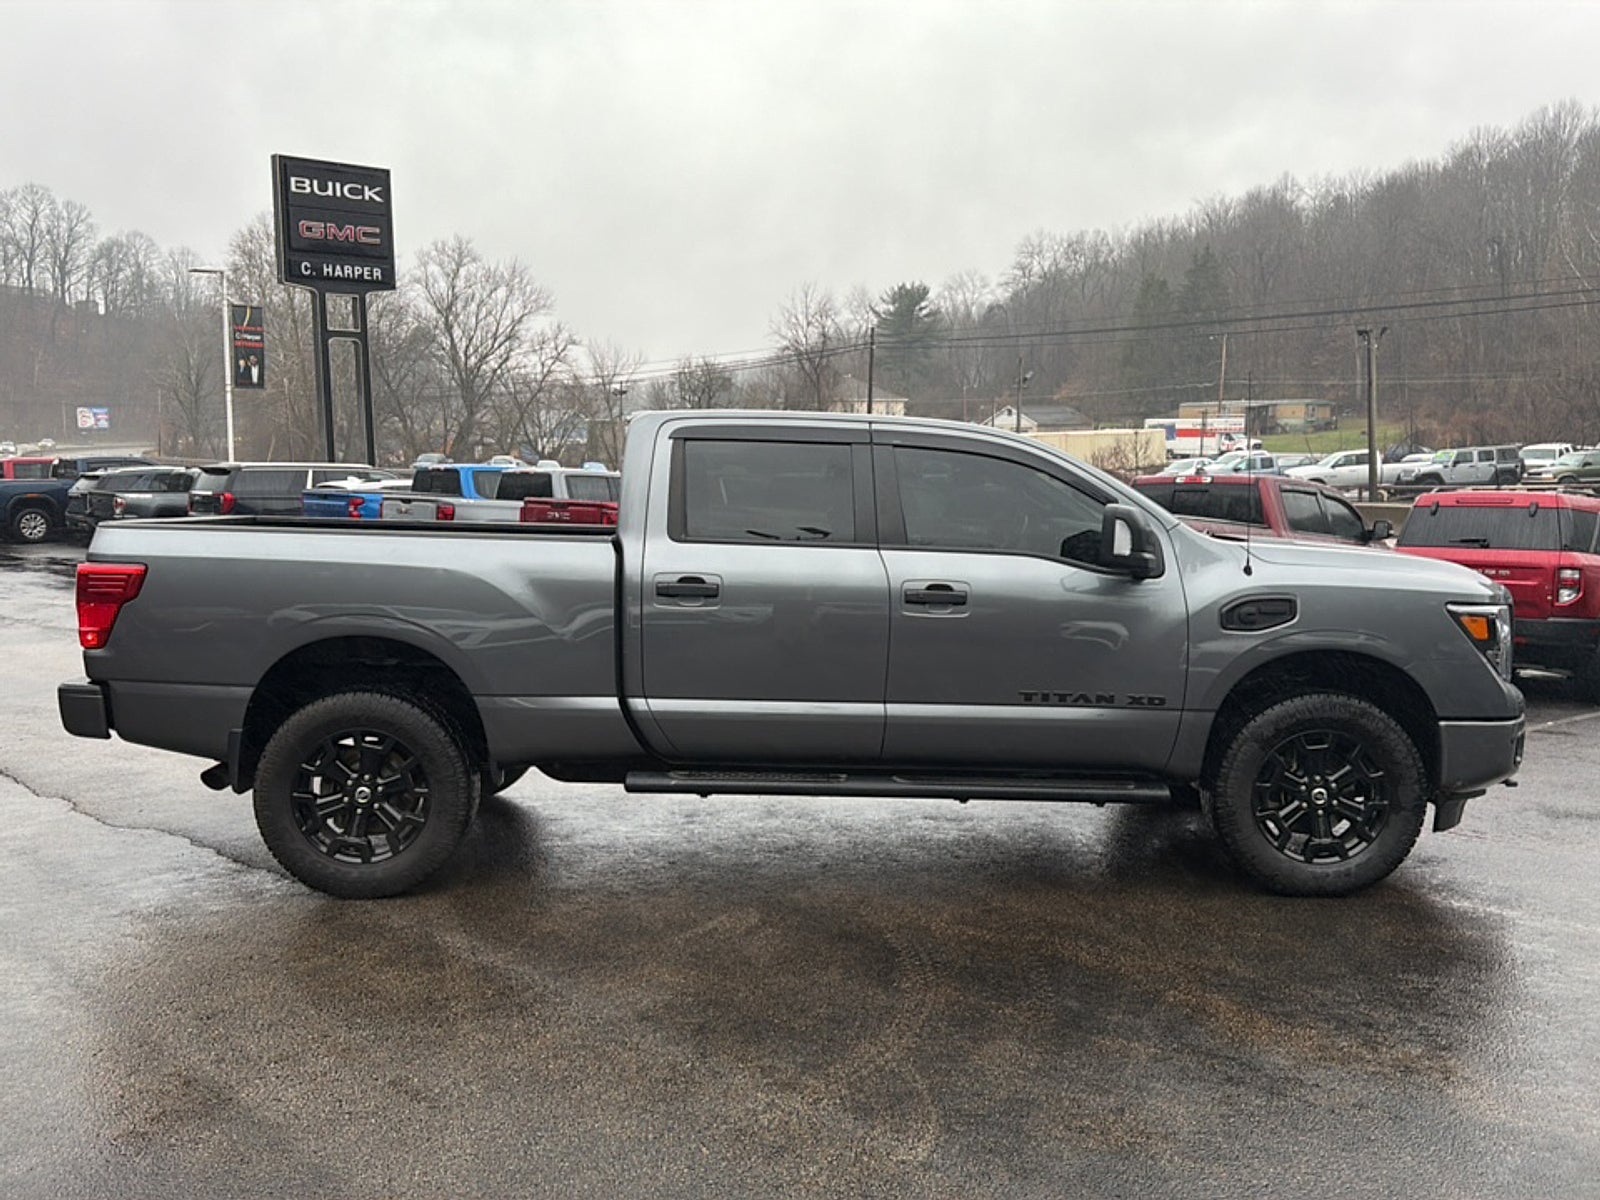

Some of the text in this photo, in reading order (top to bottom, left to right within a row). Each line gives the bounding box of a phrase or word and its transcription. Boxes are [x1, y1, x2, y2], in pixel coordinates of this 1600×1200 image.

[290, 176, 384, 203] BUICK
[298, 220, 381, 244] GMC
[301, 261, 382, 281] C. HARPER
[1018, 691, 1167, 706] TITAN XD
